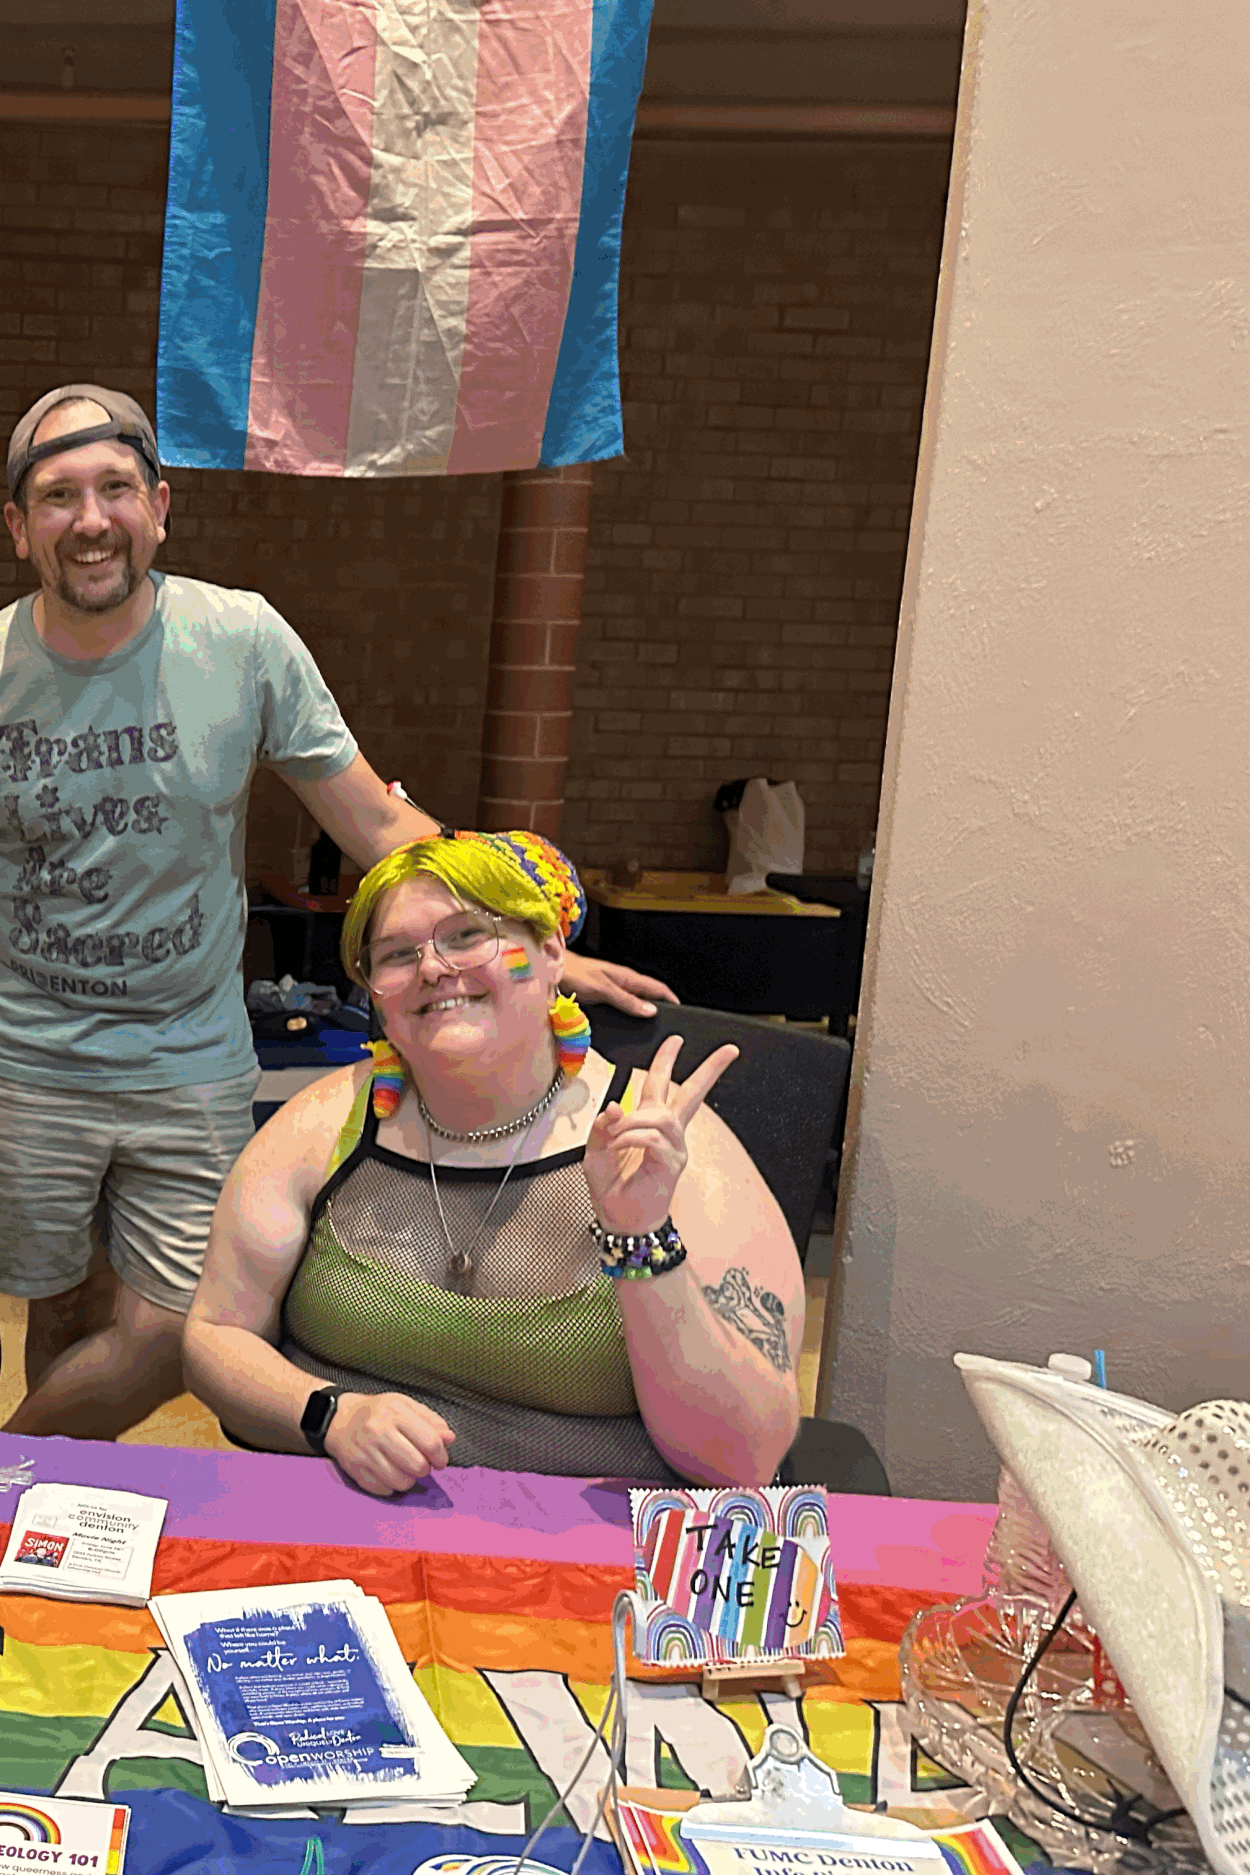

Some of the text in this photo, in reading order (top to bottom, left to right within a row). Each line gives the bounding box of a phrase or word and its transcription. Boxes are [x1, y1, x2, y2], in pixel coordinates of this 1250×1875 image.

[4, 784, 169, 844] Lives
[13, 845, 112, 905] Are
[9, 892, 203, 968] Sacred
[68, 1514, 139, 1530] community
[80, 1510, 131, 1522] envision
[79, 1521, 124, 1533] denton
[25, 1537, 64, 1551] SIMON
[72, 1532, 127, 1545] Movie Night
[686, 1524, 781, 1569] TAKE
[690, 1569, 755, 1607] ONE
[207, 1643, 360, 1673] No matter what.
[288, 1727, 326, 1745] Radical
[332, 1730, 361, 1746] Denton
[265, 1747, 374, 1768] openWORSHIP
[68, 1854, 99, 1868] 101
[733, 1847, 915, 1872] FUMC Denton
[12, 1863, 68, 1875] queerness
